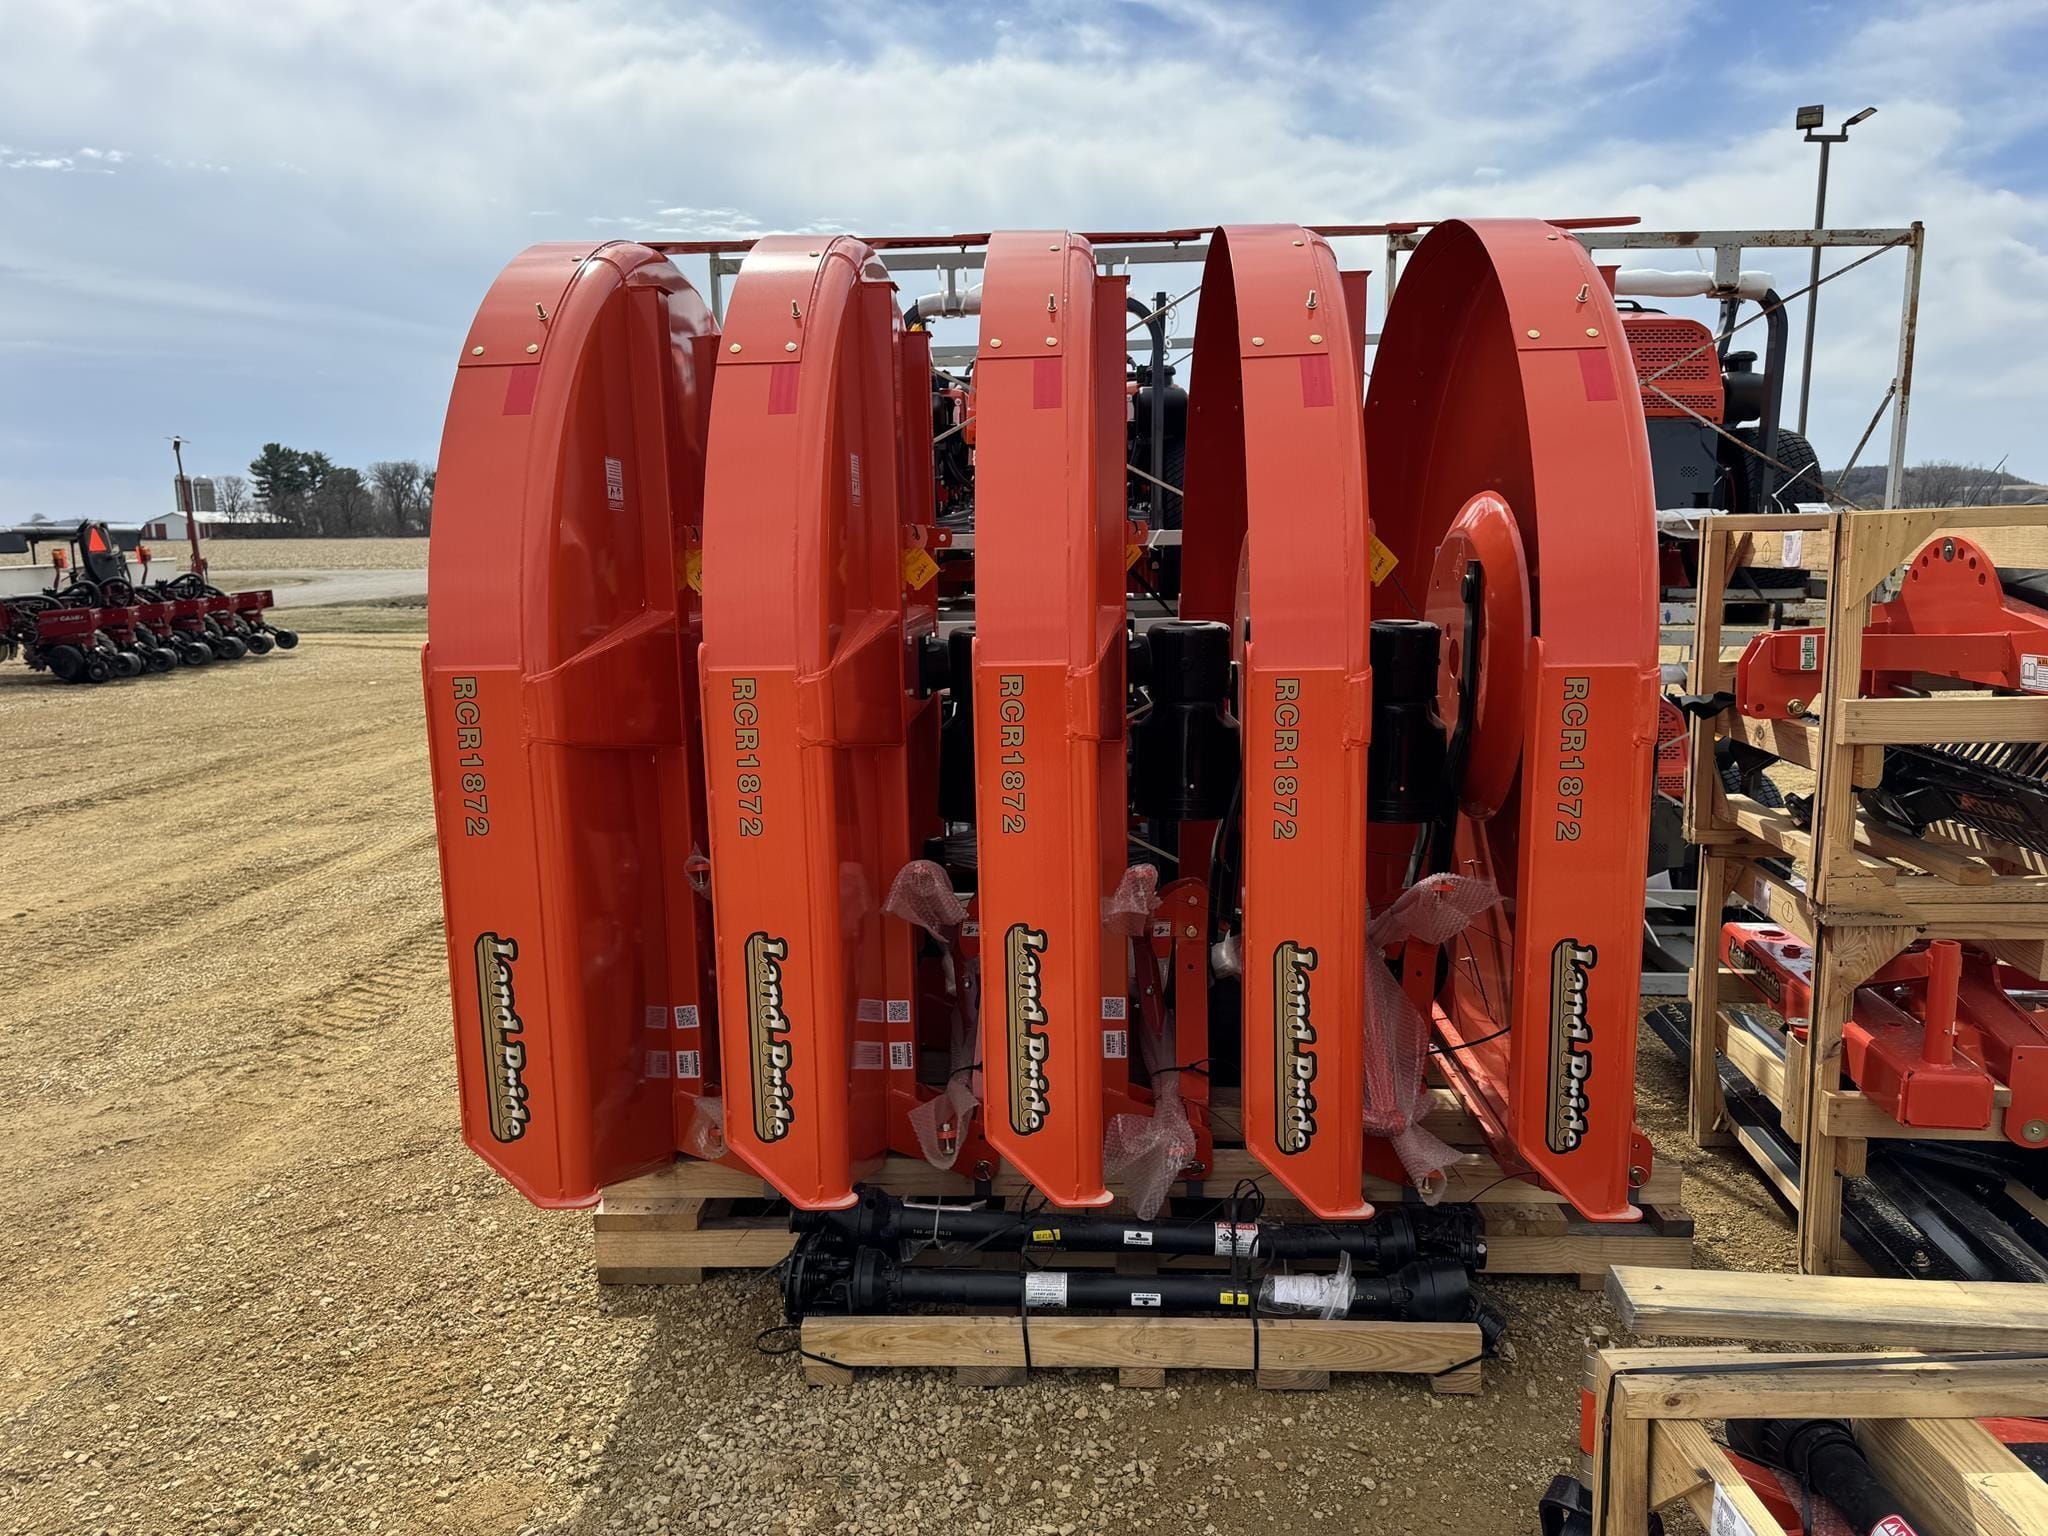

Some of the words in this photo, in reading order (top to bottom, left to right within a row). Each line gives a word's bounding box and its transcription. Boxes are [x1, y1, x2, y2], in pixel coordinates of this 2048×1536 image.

[453, 677, 489, 836] RCR1872
[733, 678, 763, 836] RCR1872
[1000, 675, 1025, 833] RCR1872
[1274, 679, 1300, 840] RCR1872
[1556, 677, 1589, 841] RCR1872
[485, 936, 521, 1033] Land
[756, 937, 787, 1032] Land
[1016, 928, 1046, 1023] Land
[1286, 946, 1316, 1043] Land
[1561, 944, 1596, 1041] Land
[494, 1042, 531, 1139] Pride
[762, 1041, 793, 1139] Pride
[1018, 1033, 1049, 1132] Pride
[1286, 1052, 1316, 1151] Pride
[1557, 1051, 1591, 1149] Pride
